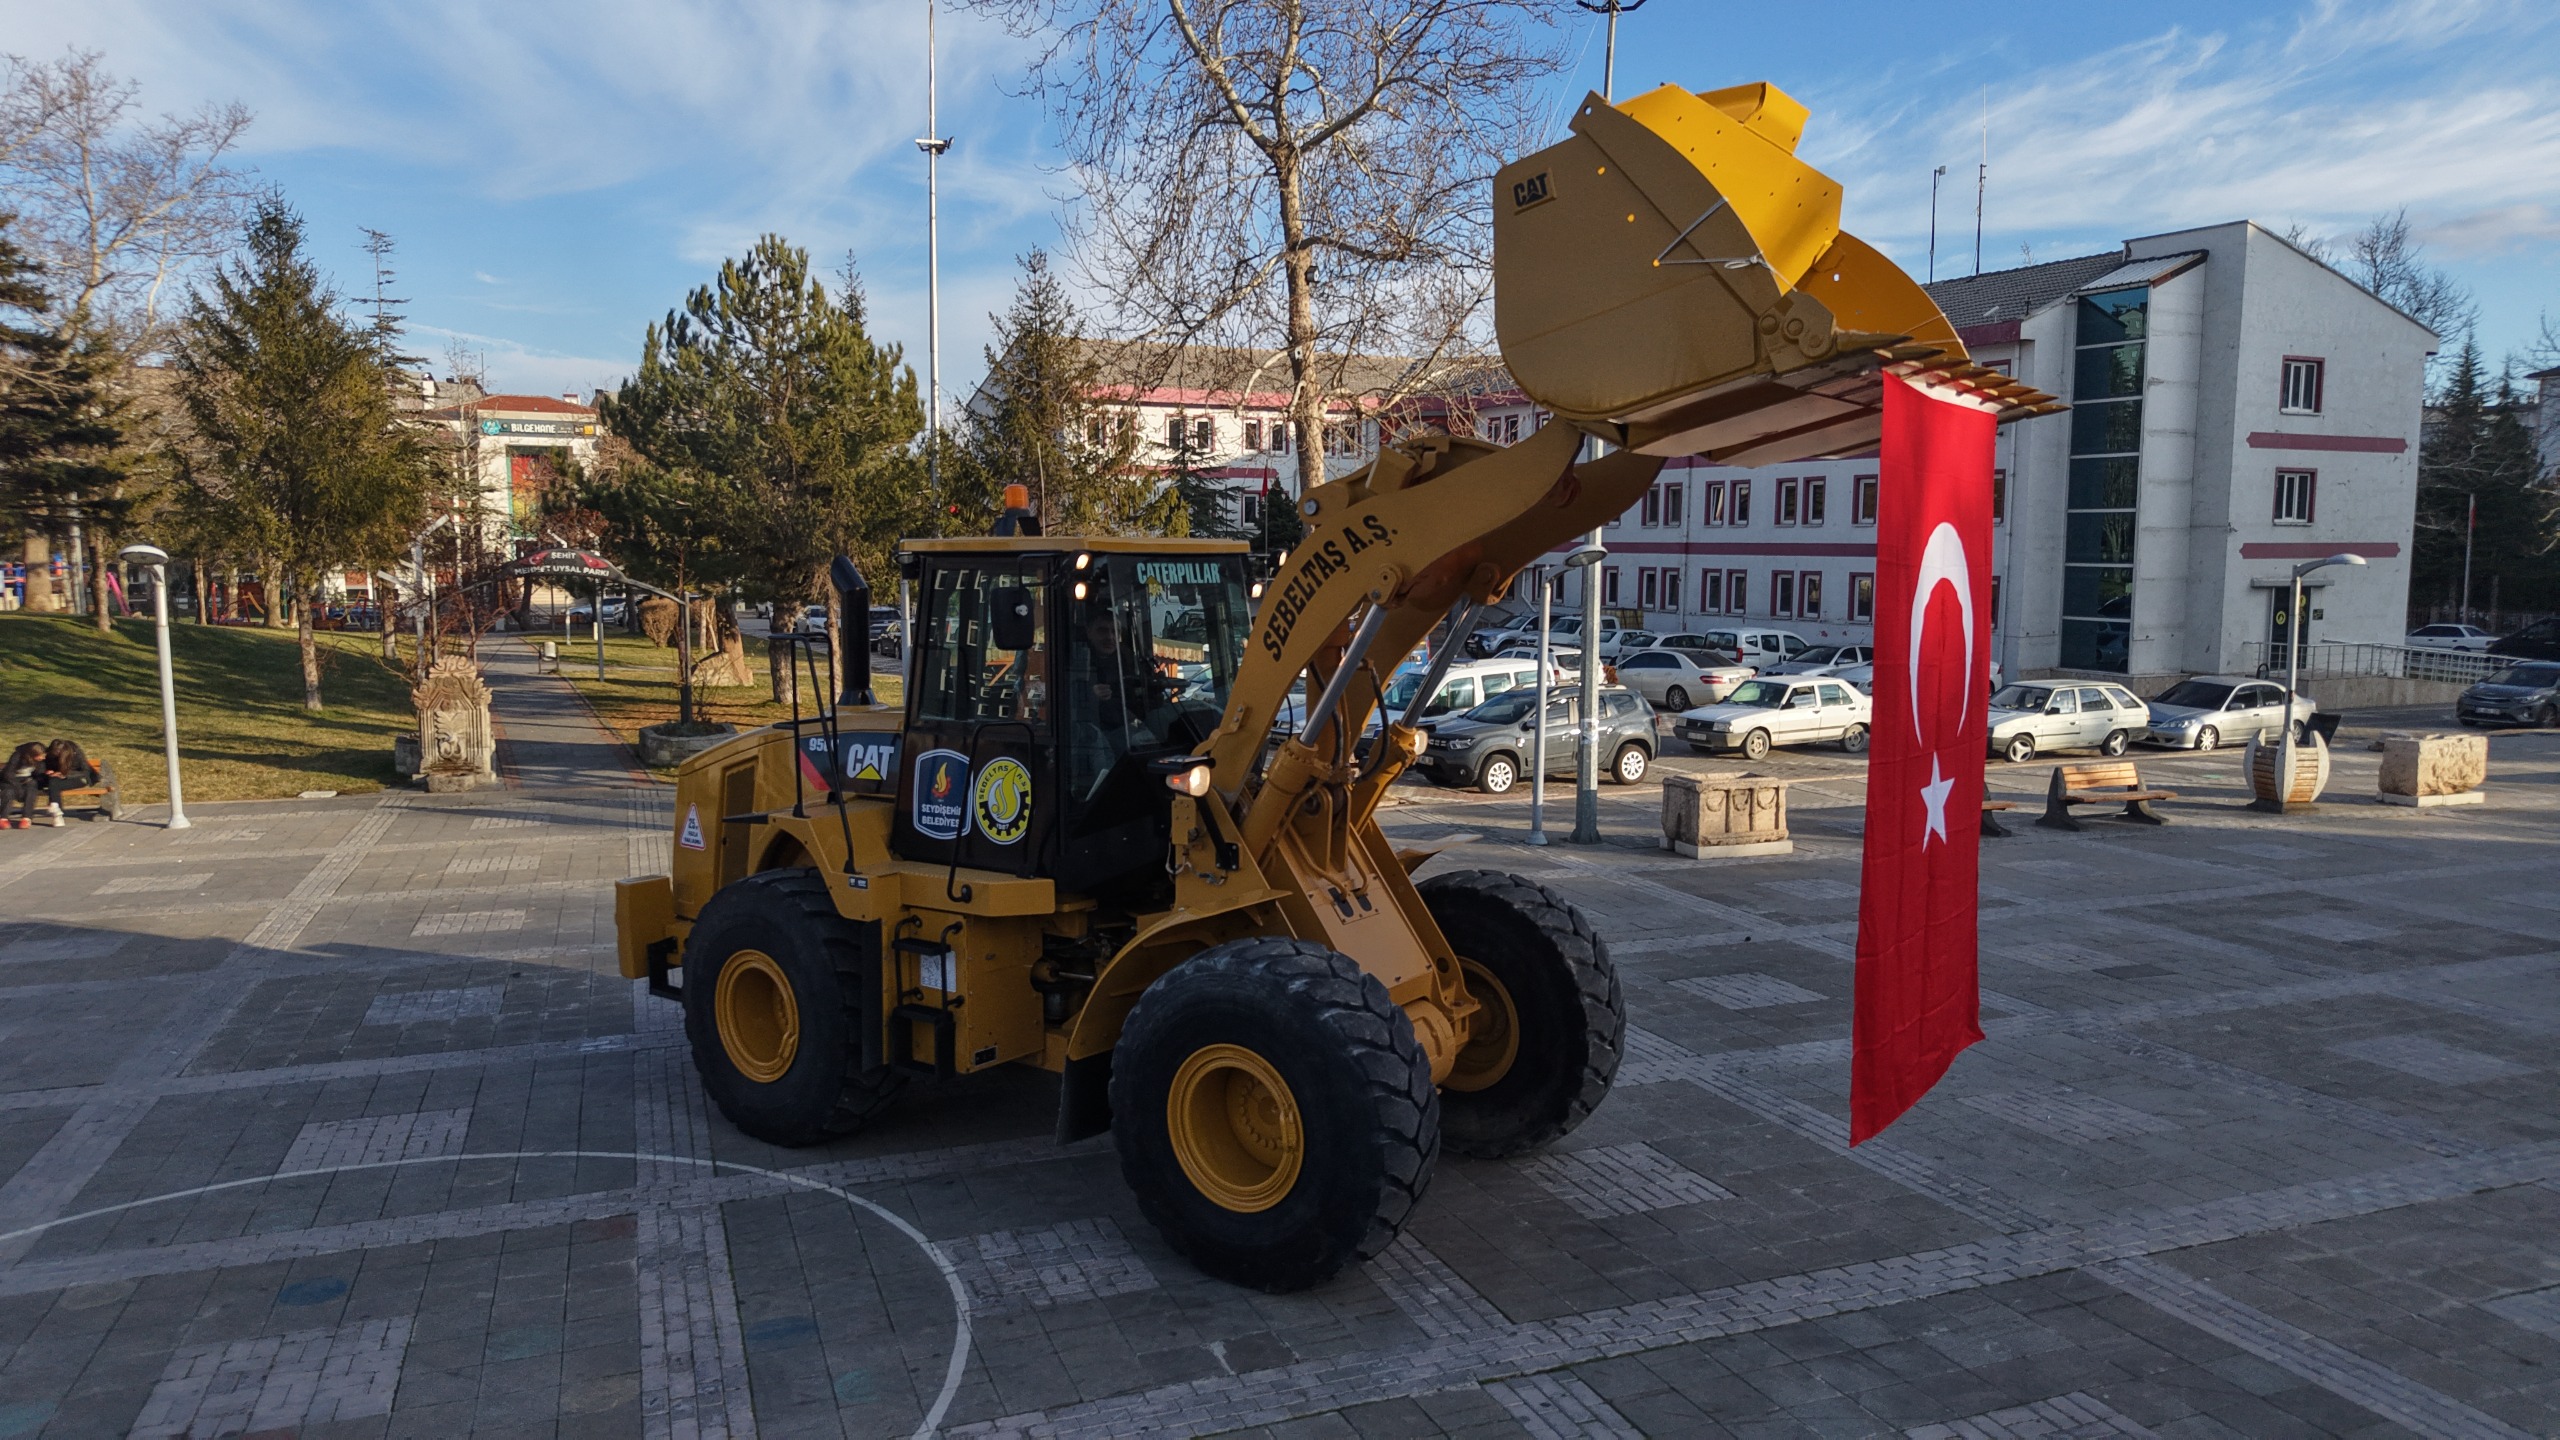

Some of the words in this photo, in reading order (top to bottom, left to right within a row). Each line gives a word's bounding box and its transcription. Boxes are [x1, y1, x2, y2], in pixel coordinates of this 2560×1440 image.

[1513, 172, 1548, 207] CAT
[511, 423, 556, 433] BİLGEHANE
[551, 551, 577, 560] ŞEHİT
[553, 565, 581, 573] UYSAL
[583, 567, 610, 577] PARKI
[1137, 562, 1221, 584] CATERPILLAR
[1262, 541, 1351, 662] SEBELTAŞ
[1342, 515, 1399, 554] A.Ş.
[846, 743, 895, 781] CAT
[921, 815, 959, 828] BELEDİYES
